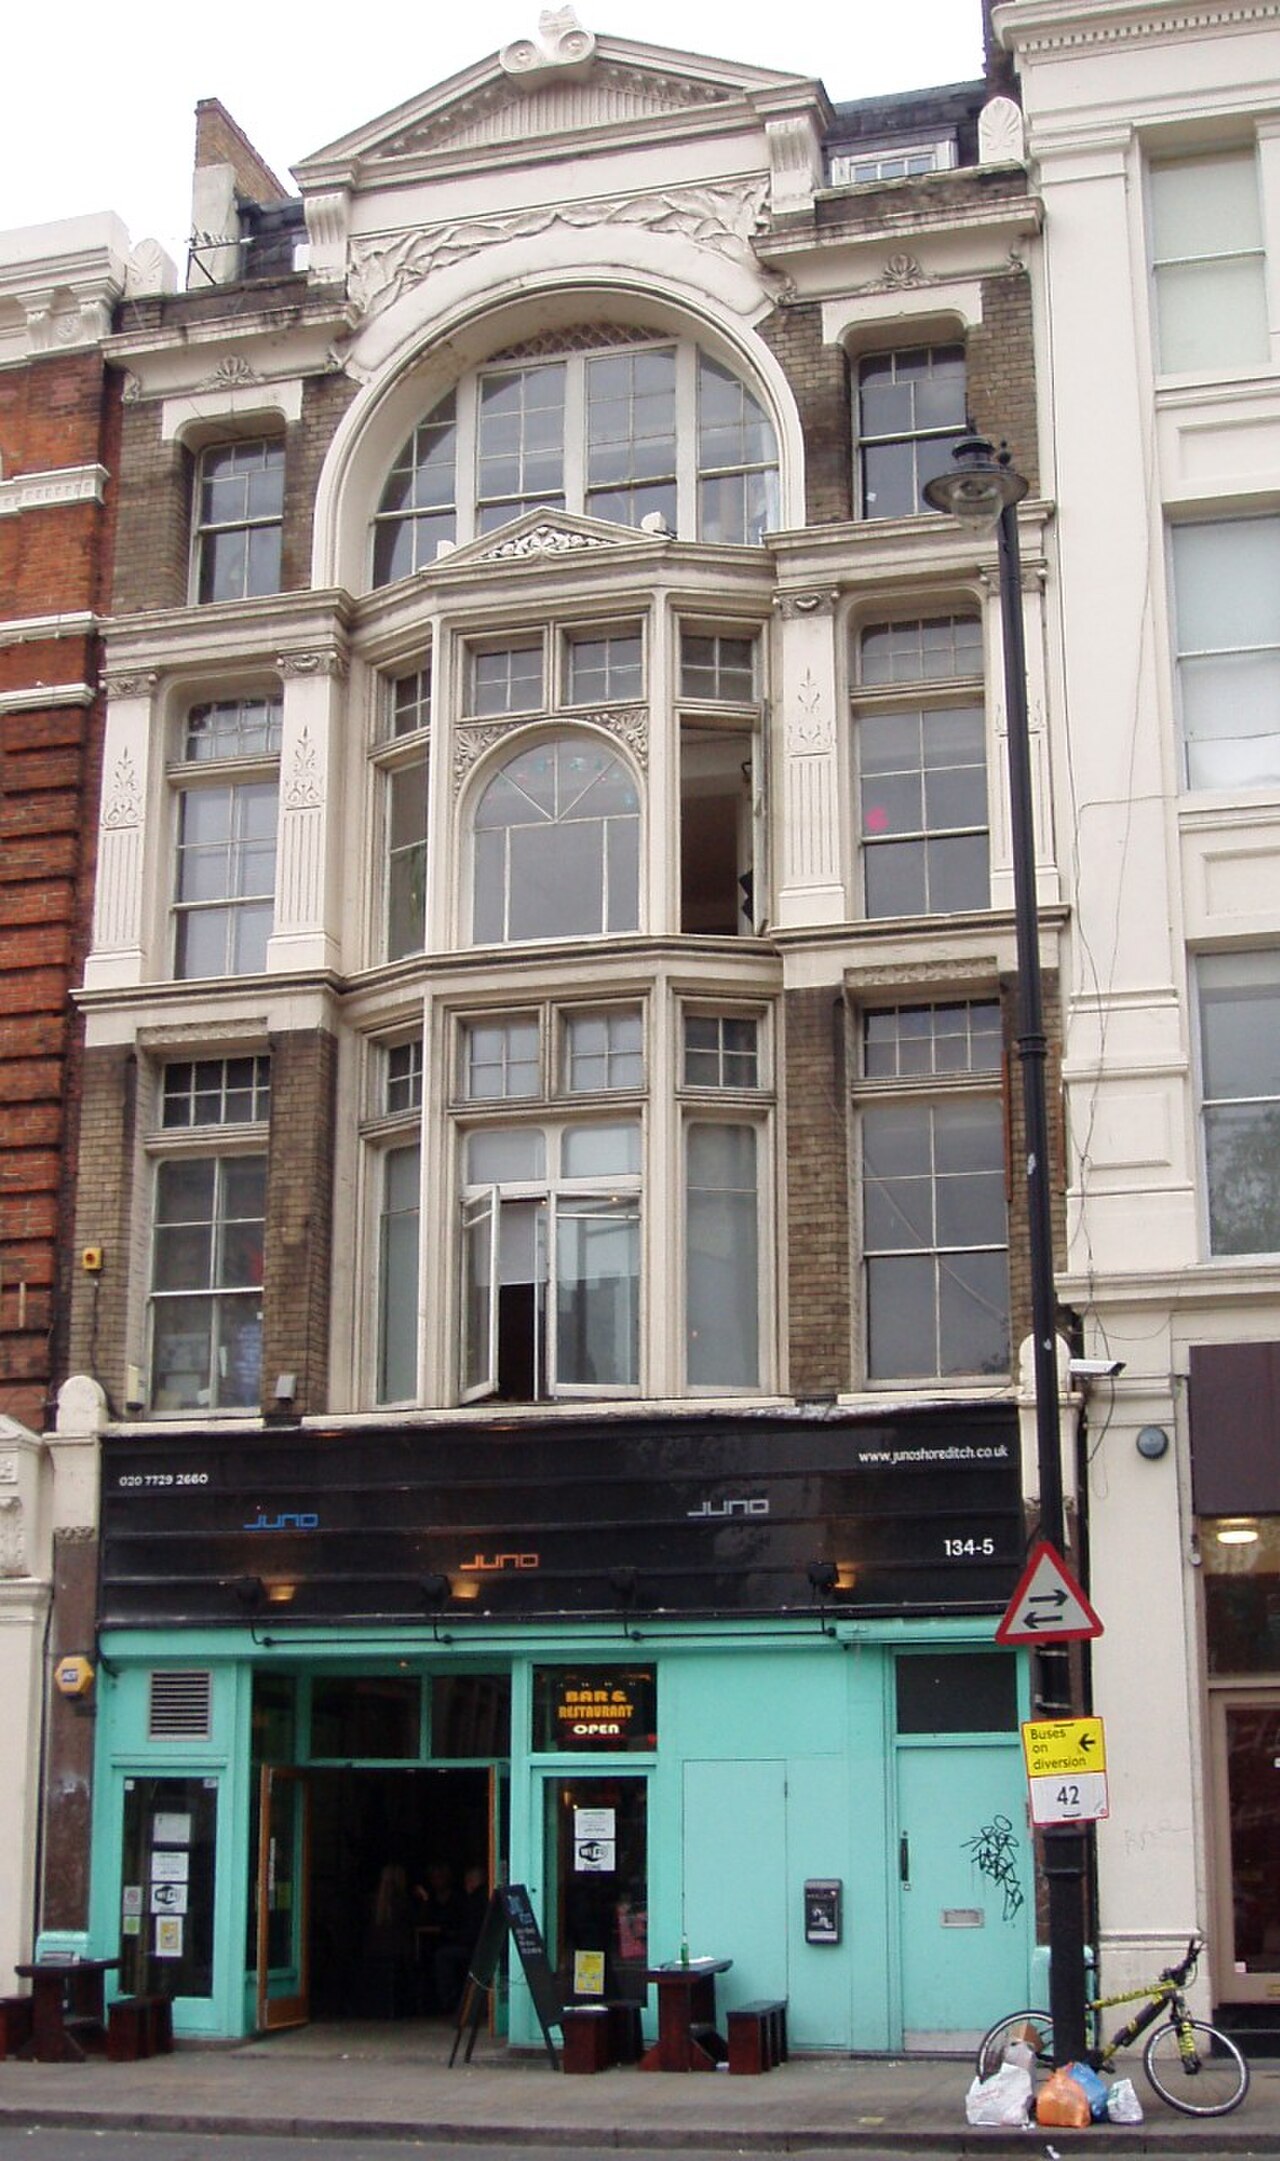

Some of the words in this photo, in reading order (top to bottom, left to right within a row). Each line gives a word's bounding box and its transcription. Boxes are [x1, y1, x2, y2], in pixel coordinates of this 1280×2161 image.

[858, 1445, 1009, 1465] www.junoshoreditch.co.uk
[119, 1476, 143, 1487] 020
[145, 1474, 174, 1486] 7729
[176, 1473, 208, 1485] 2660
[944, 1538, 994, 1556] 134-5
[565, 1690, 609, 1703] BAR
[611, 1690, 627, 1703] &
[558, 1705, 634, 1719] RESTAURANT
[573, 1724, 620, 1735] OPEN
[1030, 1728, 1067, 1741] Buses
[1032, 1744, 1048, 1754] on
[1033, 1756, 1087, 1770] diversion
[1056, 1785, 1080, 1805] 42
